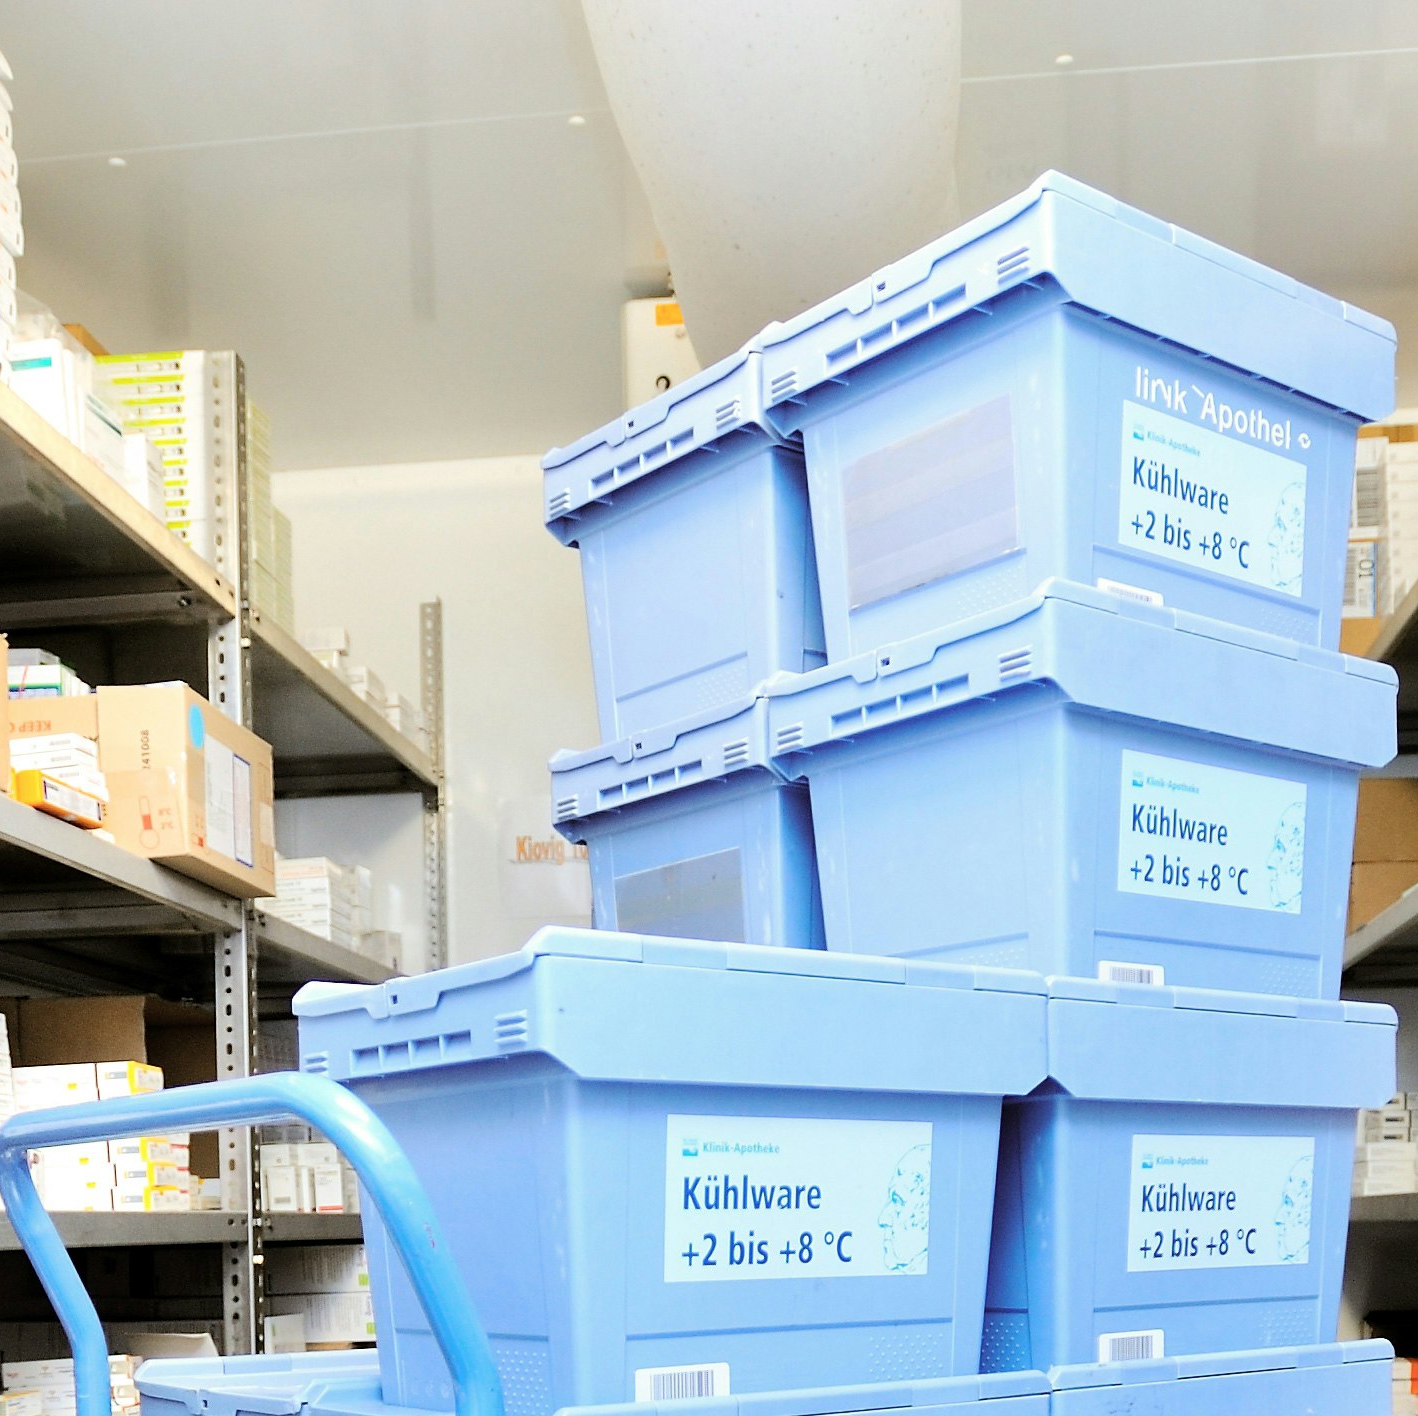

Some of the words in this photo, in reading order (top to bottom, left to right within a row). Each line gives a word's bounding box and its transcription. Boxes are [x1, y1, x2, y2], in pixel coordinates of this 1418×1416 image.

[1132, 456, 1230, 515] Kühlware
[1130, 510, 1156, 541] +2
[1163, 513, 1191, 552] bis
[1198, 531, 1223, 560] +8
[1230, 536, 1251, 570] °C
[18, 719, 52, 733] KEEP
[1131, 803, 1229, 846] Kühlware
[516, 835, 566, 866] Kiovig
[1130, 853, 1154, 883] +2
[1162, 854, 1190, 888] bis
[1197, 863, 1221, 892] +8
[1228, 866, 1249, 896] °C
[702, 1142, 780, 1156] Klinik-Apotheke
[683, 1174, 823, 1210] Kühlware
[1141, 1182, 1237, 1213] Kühlware
[681, 1232, 718, 1267] +2
[728, 1230, 769, 1266] bis
[779, 1230, 813, 1264] +8
[824, 1230, 853, 1263] °C
[1139, 1230, 1164, 1259] +2
[1171, 1228, 1199, 1258] bis
[1205, 1228, 1229, 1256] +8
[1236, 1228, 1257, 1255] °C
